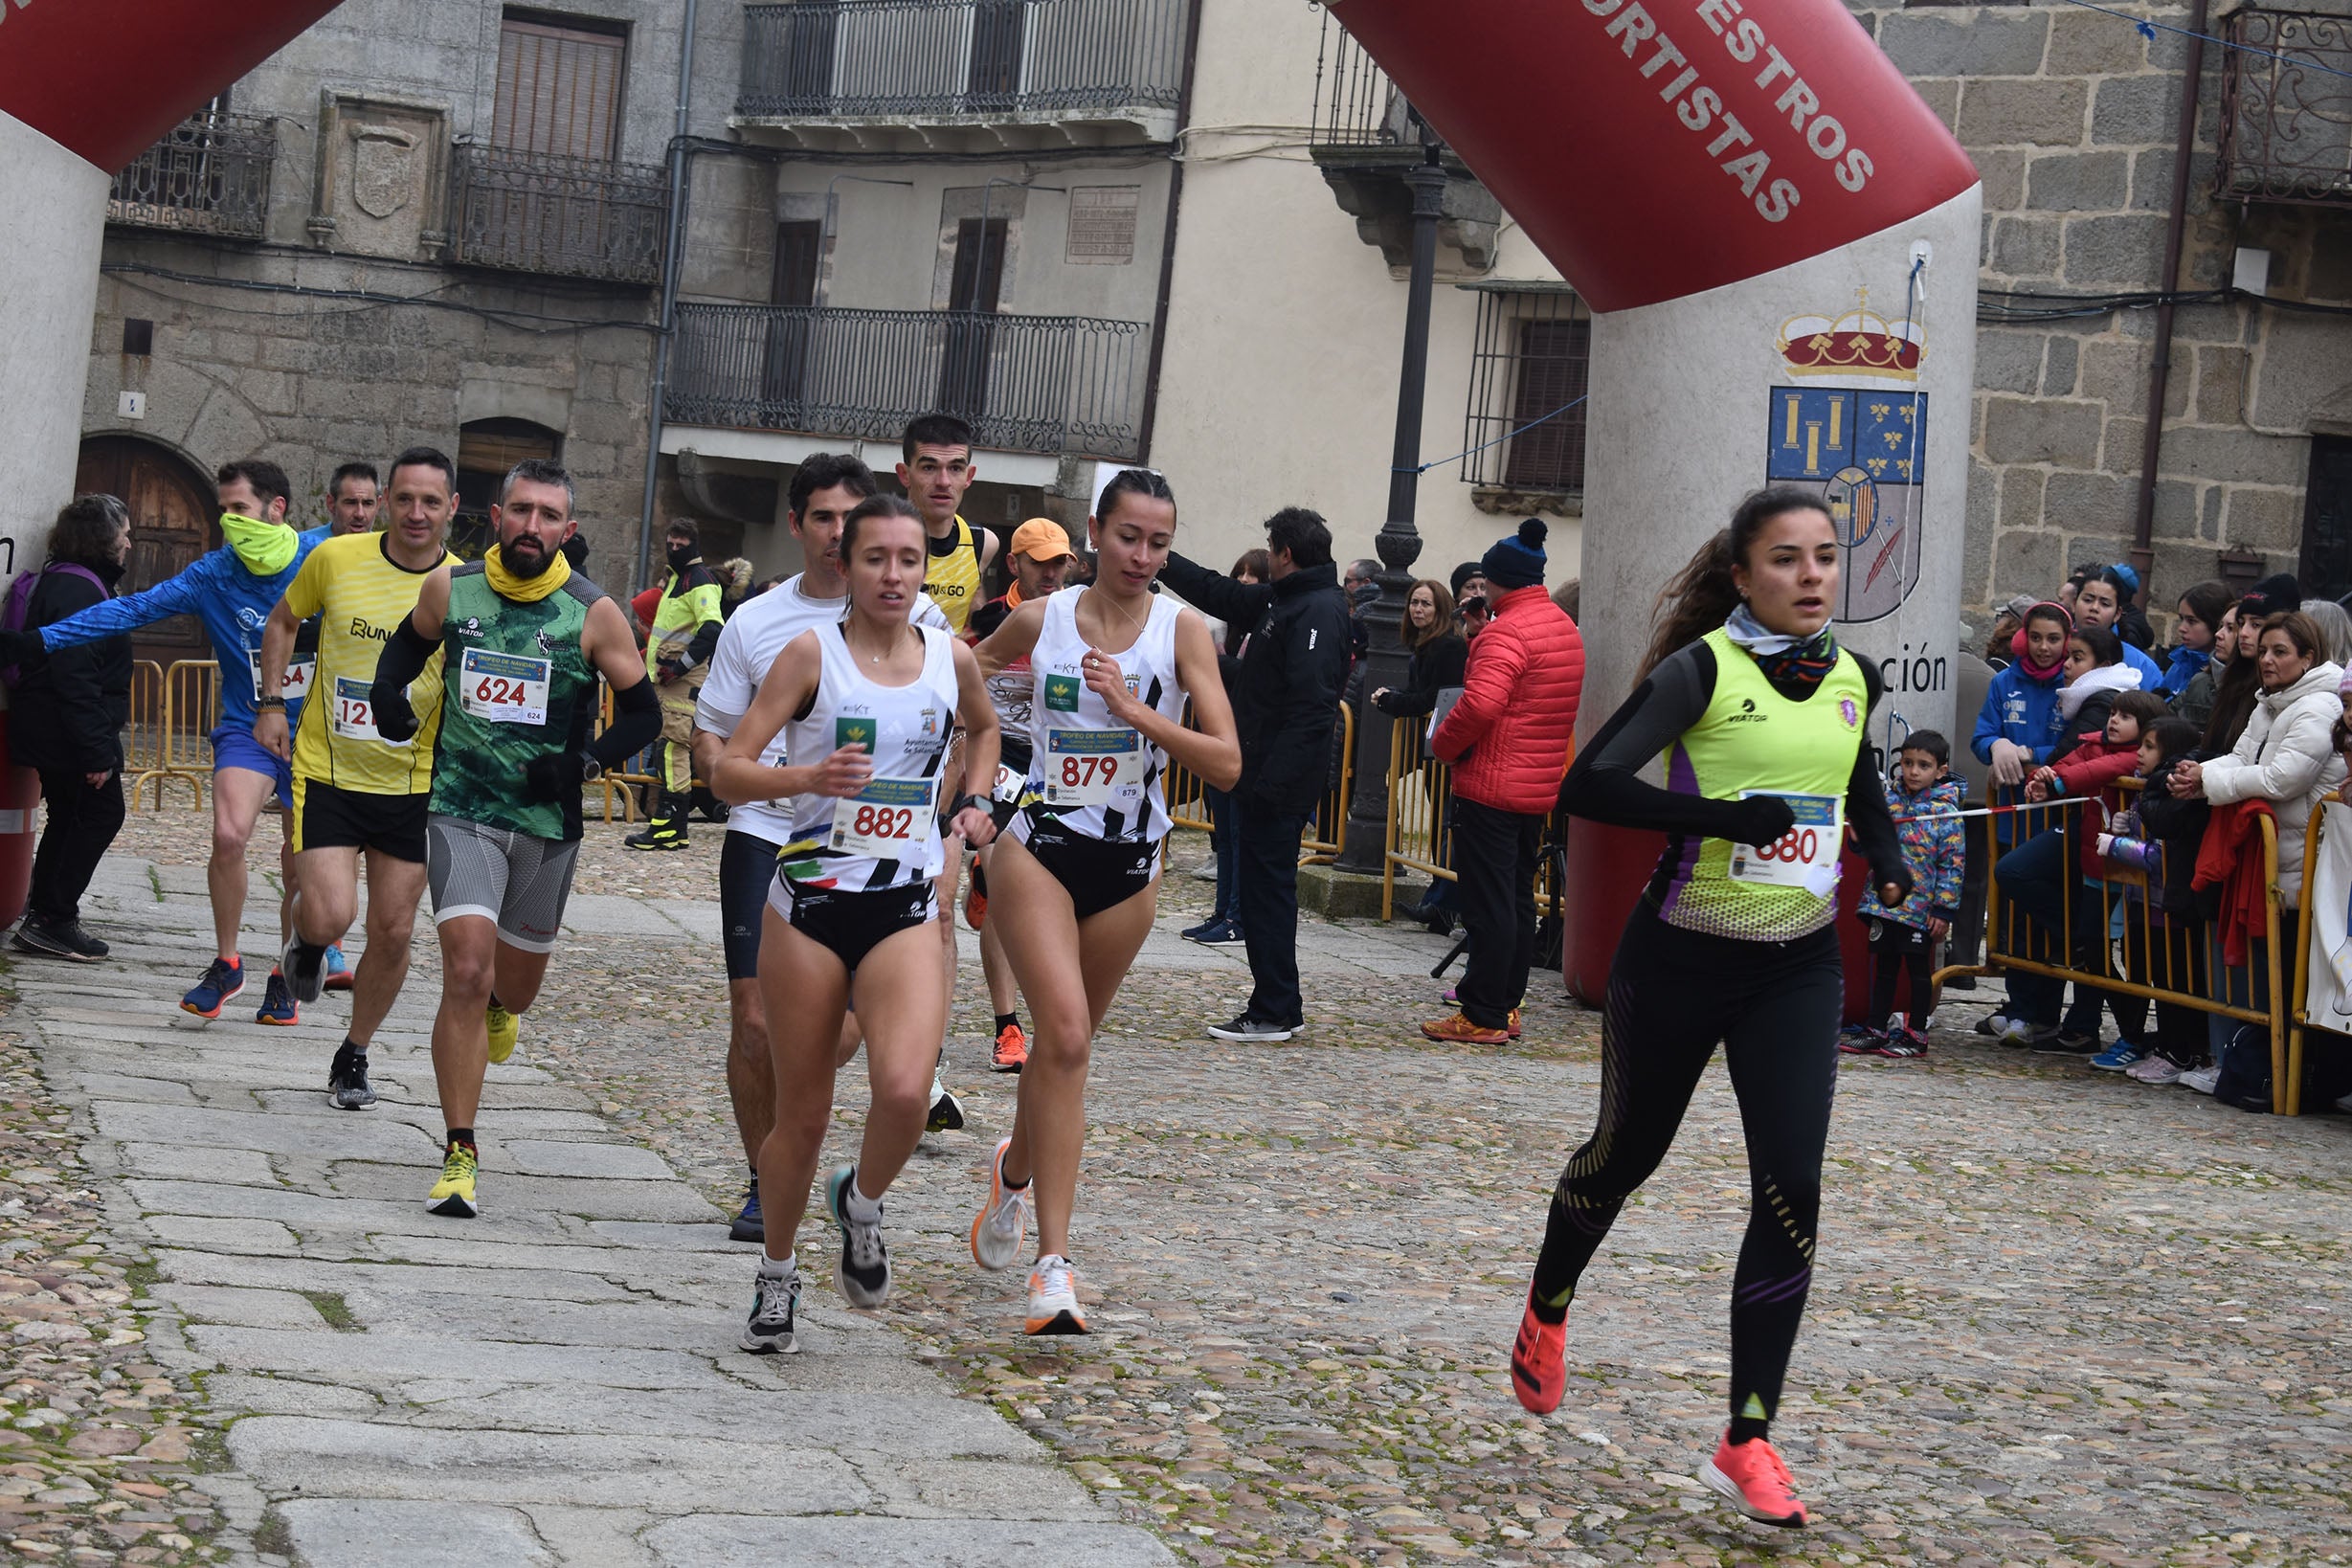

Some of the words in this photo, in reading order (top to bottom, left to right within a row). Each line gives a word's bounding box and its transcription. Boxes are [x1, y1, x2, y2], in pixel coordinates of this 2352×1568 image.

[458, 627, 484, 638] VIATOR
[1309, 628, 1318, 651] Joma
[476, 676, 526, 706] 624
[342, 700, 376, 726] 12
[1728, 714, 1768, 723] VIATOR
[1060, 731, 1084, 740] TROFEO
[1062, 756, 1118, 787] 879
[854, 805, 913, 839] 882
